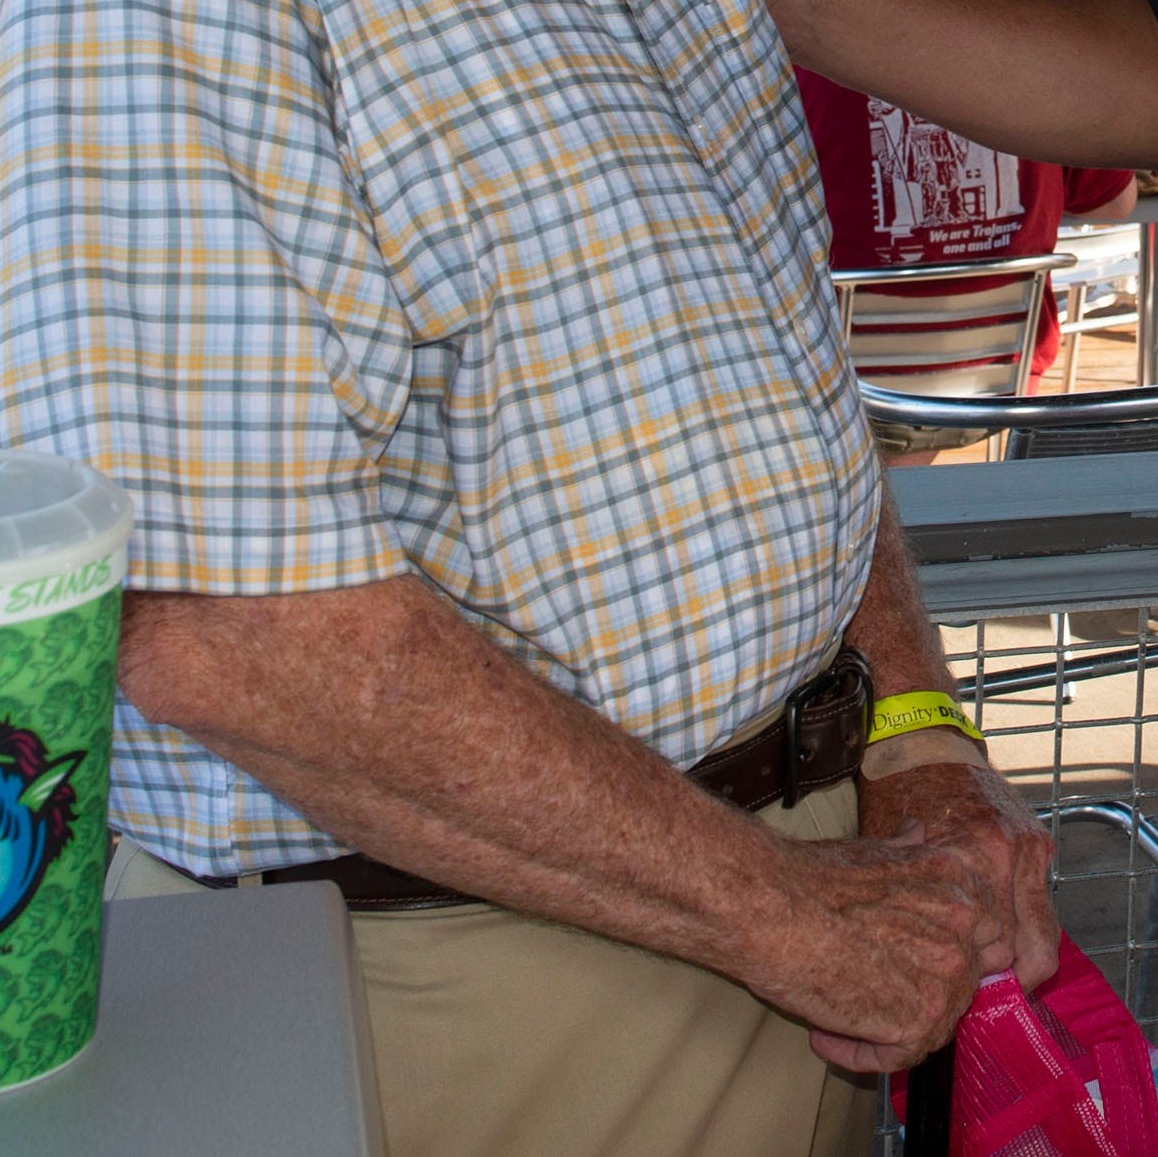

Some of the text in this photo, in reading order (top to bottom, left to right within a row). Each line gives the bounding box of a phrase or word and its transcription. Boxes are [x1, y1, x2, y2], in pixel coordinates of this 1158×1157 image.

[929, 221, 1022, 243] We are Trojans,
[942, 235, 1010, 254] one and all
[4, 553, 111, 614] STANDS
[872, 705, 935, 732] Dignity
